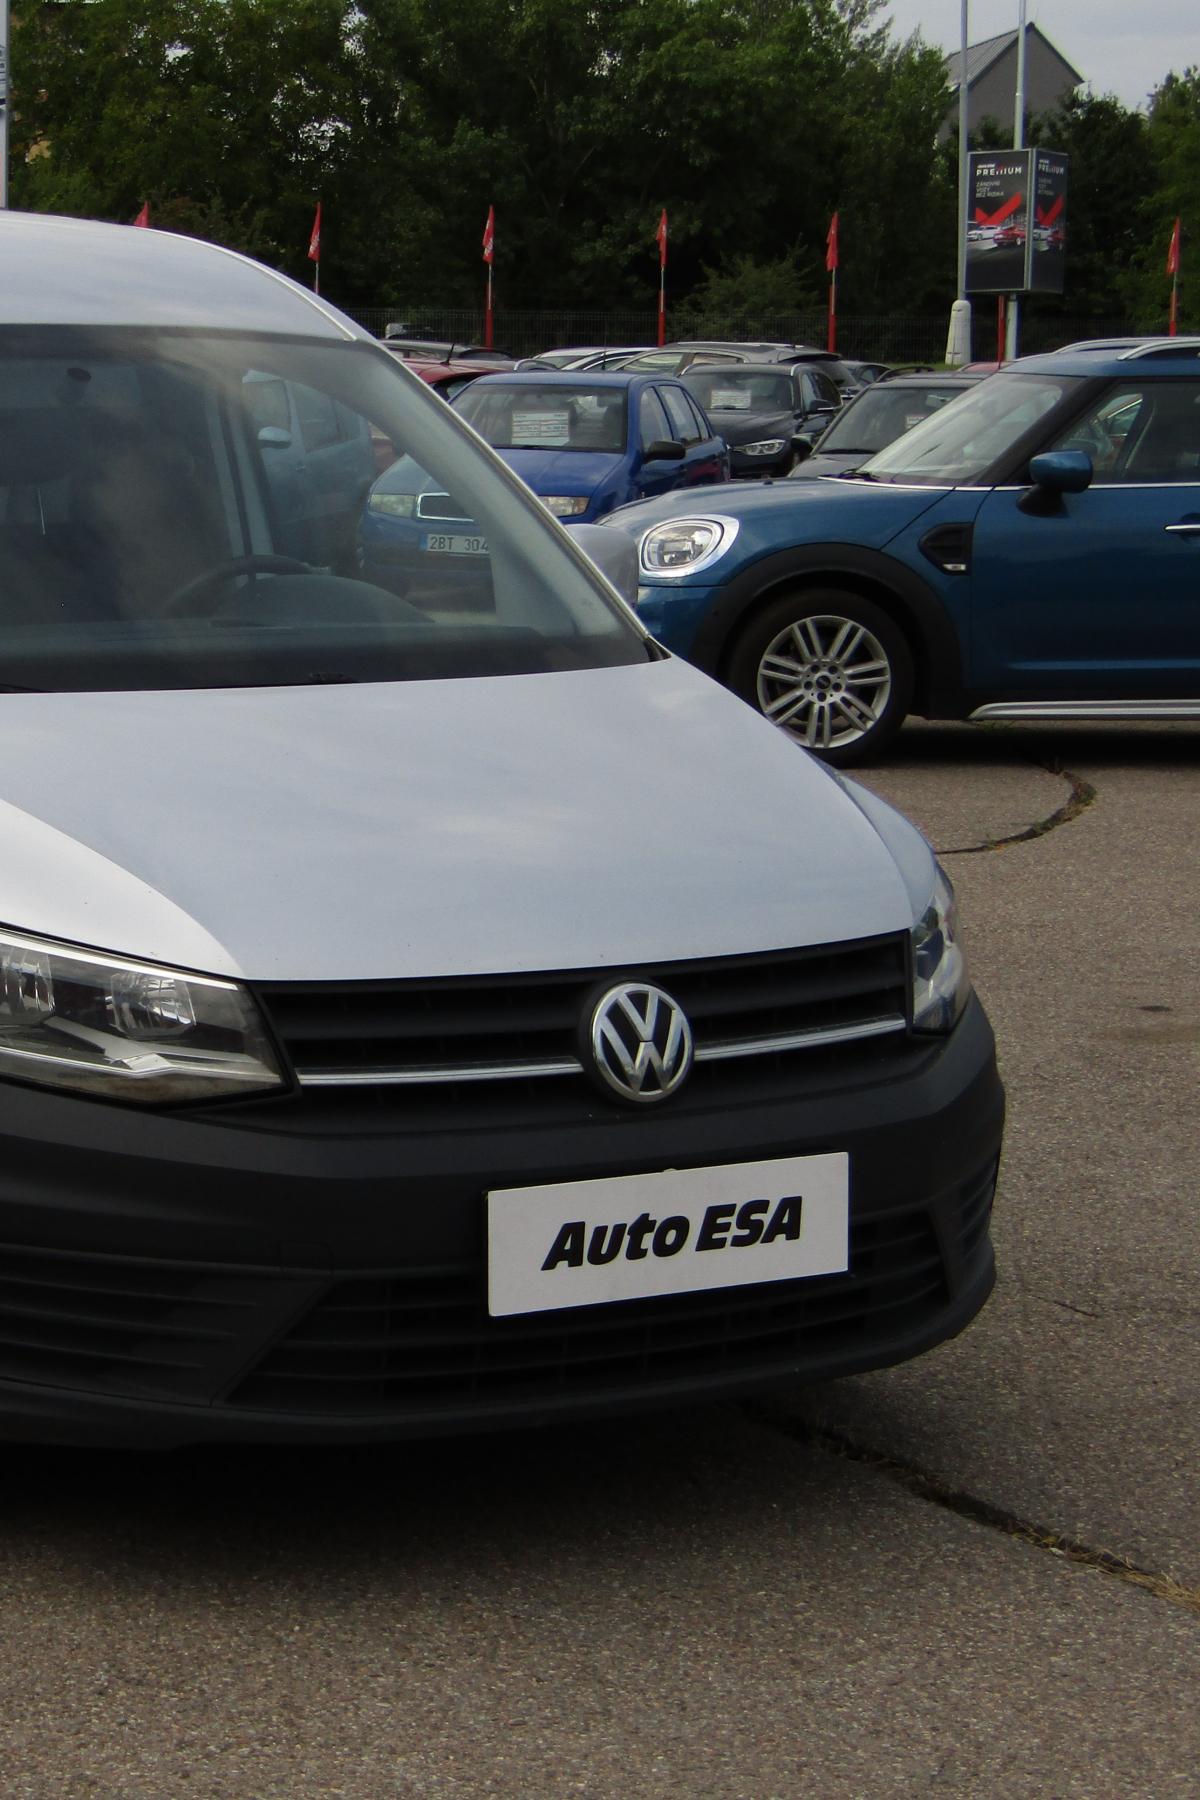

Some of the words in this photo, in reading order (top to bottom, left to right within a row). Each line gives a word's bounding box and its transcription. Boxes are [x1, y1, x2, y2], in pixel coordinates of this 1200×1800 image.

[430, 536, 455, 550] 2BT
[540, 1212, 691, 1272] Auto
[695, 1195, 803, 1252] ESA
